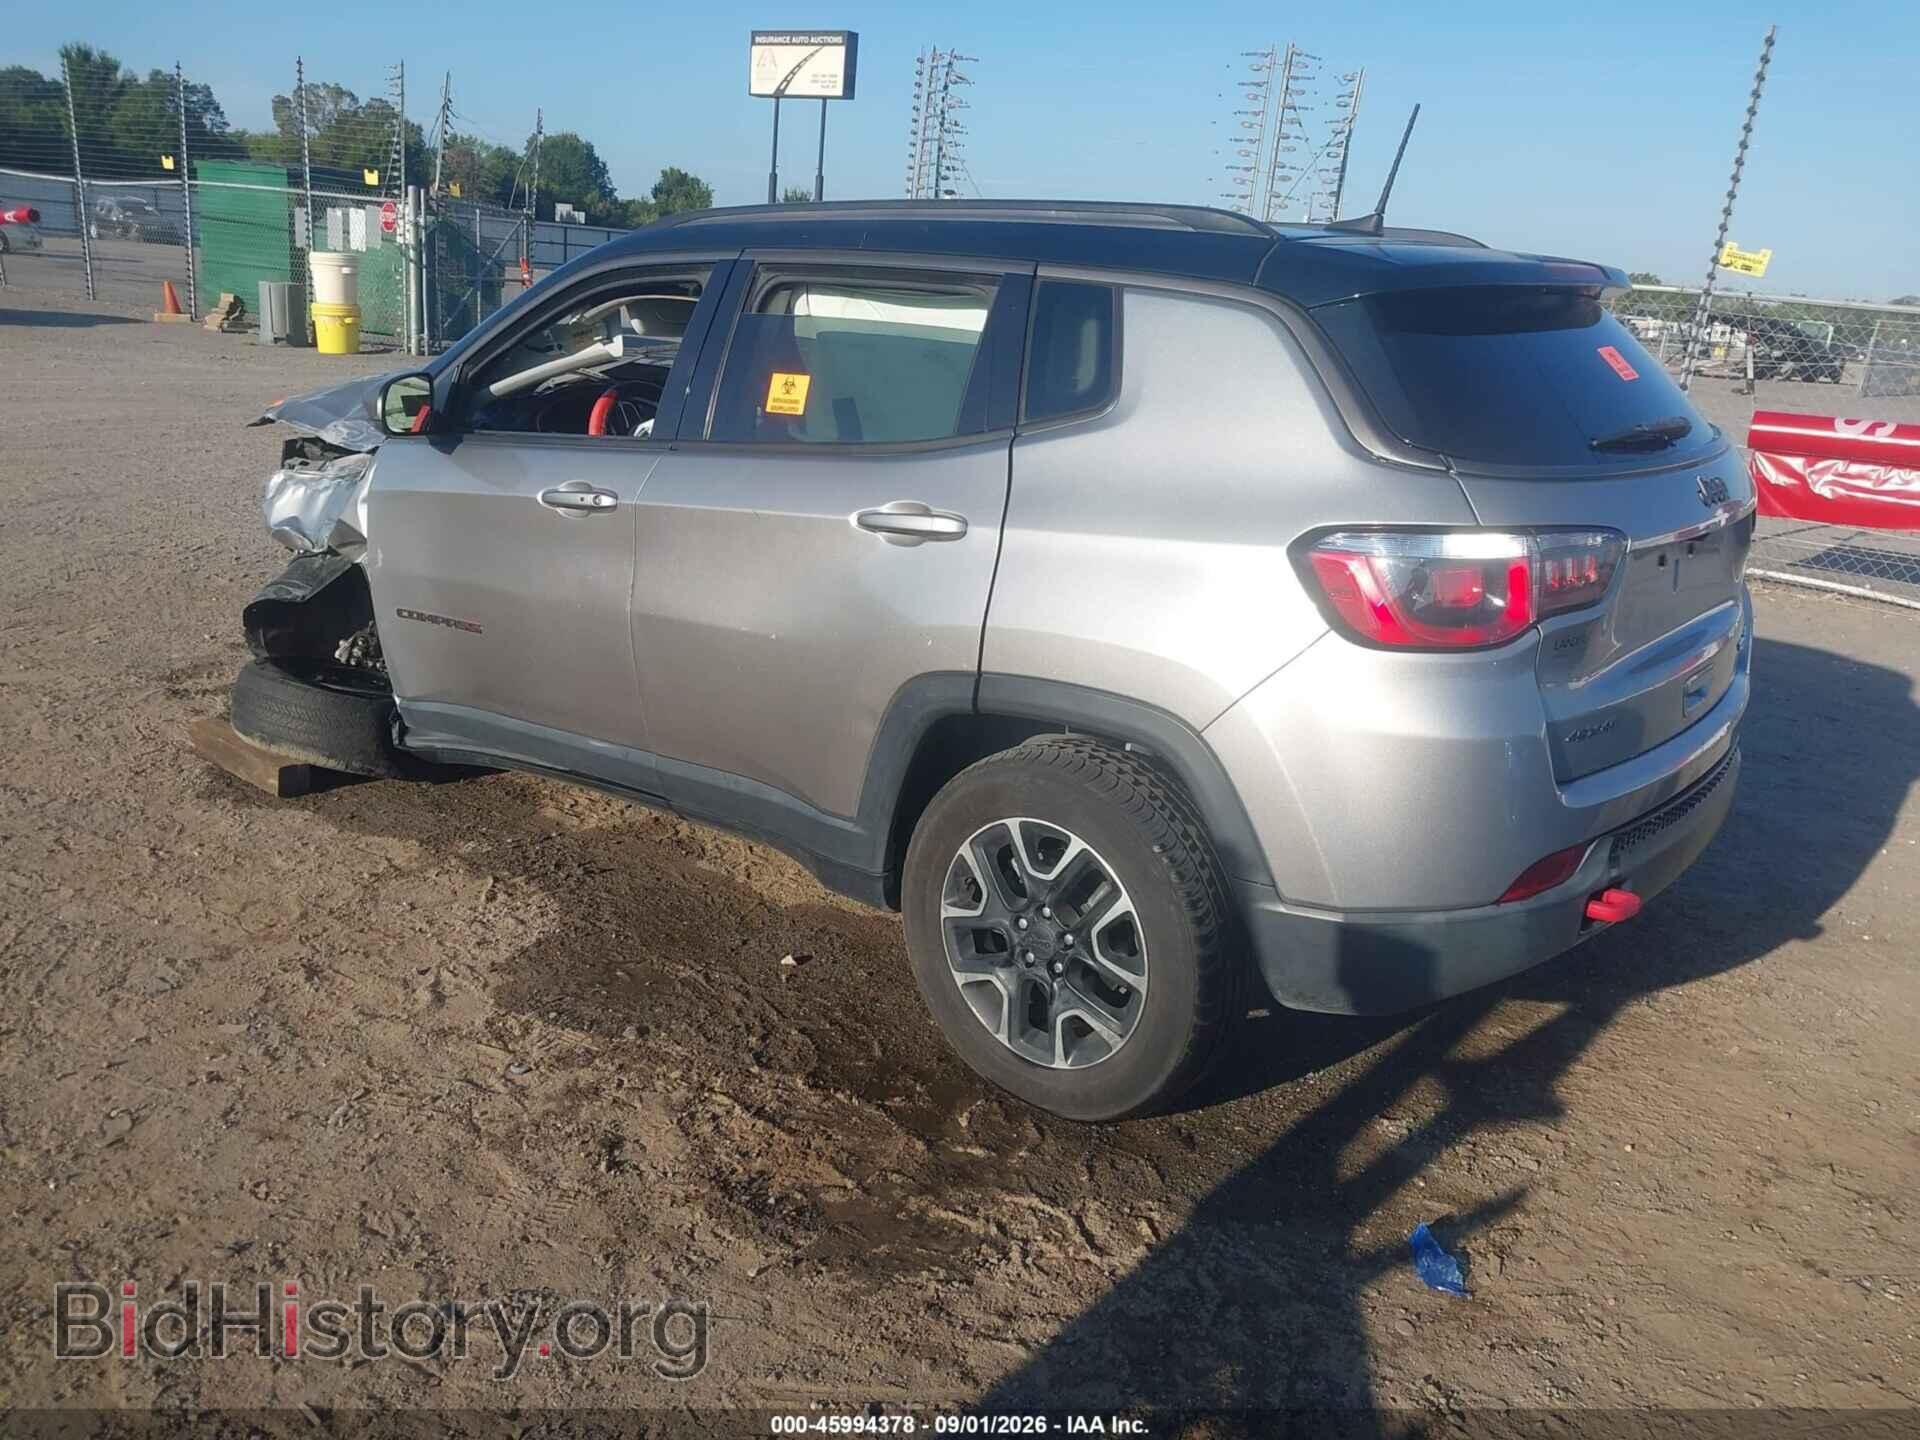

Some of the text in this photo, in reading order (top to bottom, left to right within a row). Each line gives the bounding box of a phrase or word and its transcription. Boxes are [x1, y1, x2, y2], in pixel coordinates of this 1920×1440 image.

[755, 35, 843, 44] INSURANCE AUTO AUCTIONS
[396, 608, 482, 634] COMPASS
